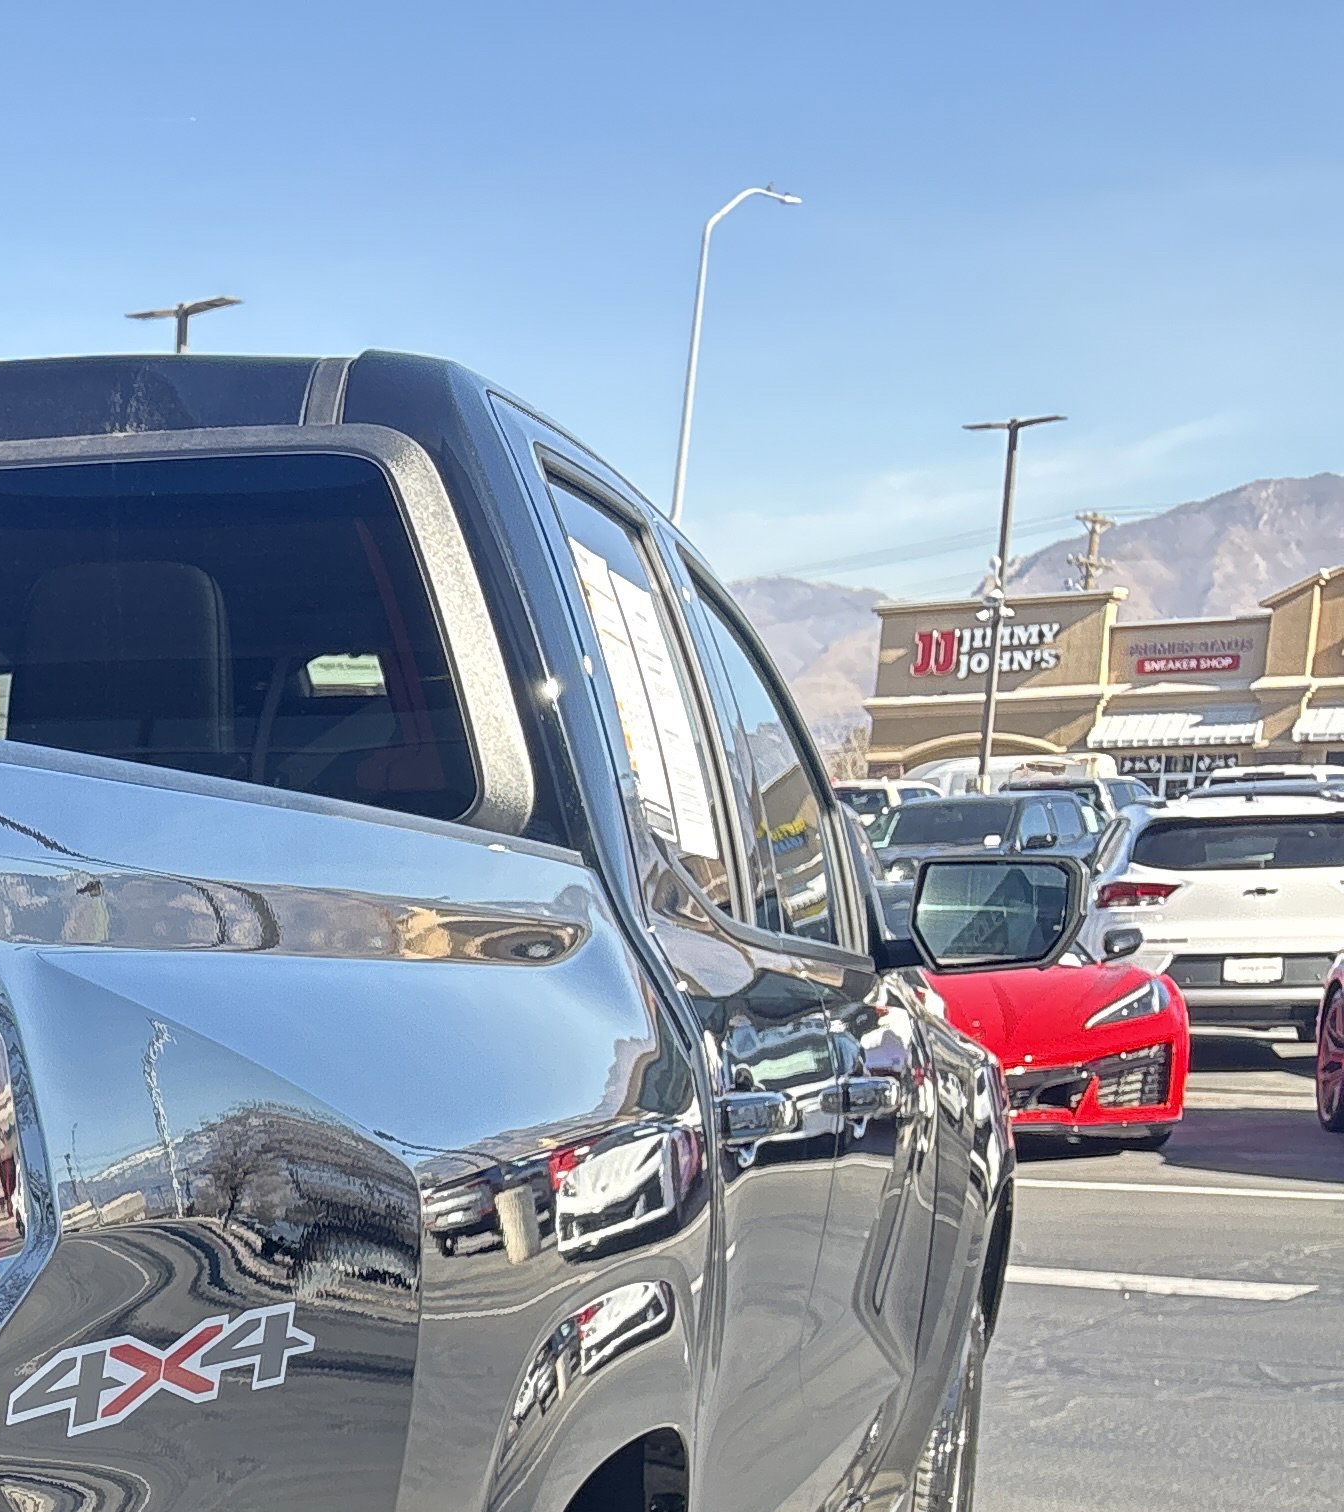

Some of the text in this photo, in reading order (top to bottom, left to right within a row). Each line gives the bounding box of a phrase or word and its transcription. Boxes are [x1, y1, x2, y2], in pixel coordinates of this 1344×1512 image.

[910, 629, 960, 677] JJ
[960, 623, 1060, 653] JIMMY
[957, 649, 1059, 680] JOHN'S
[1144, 656, 1233, 673] SNEAKER SHOP
